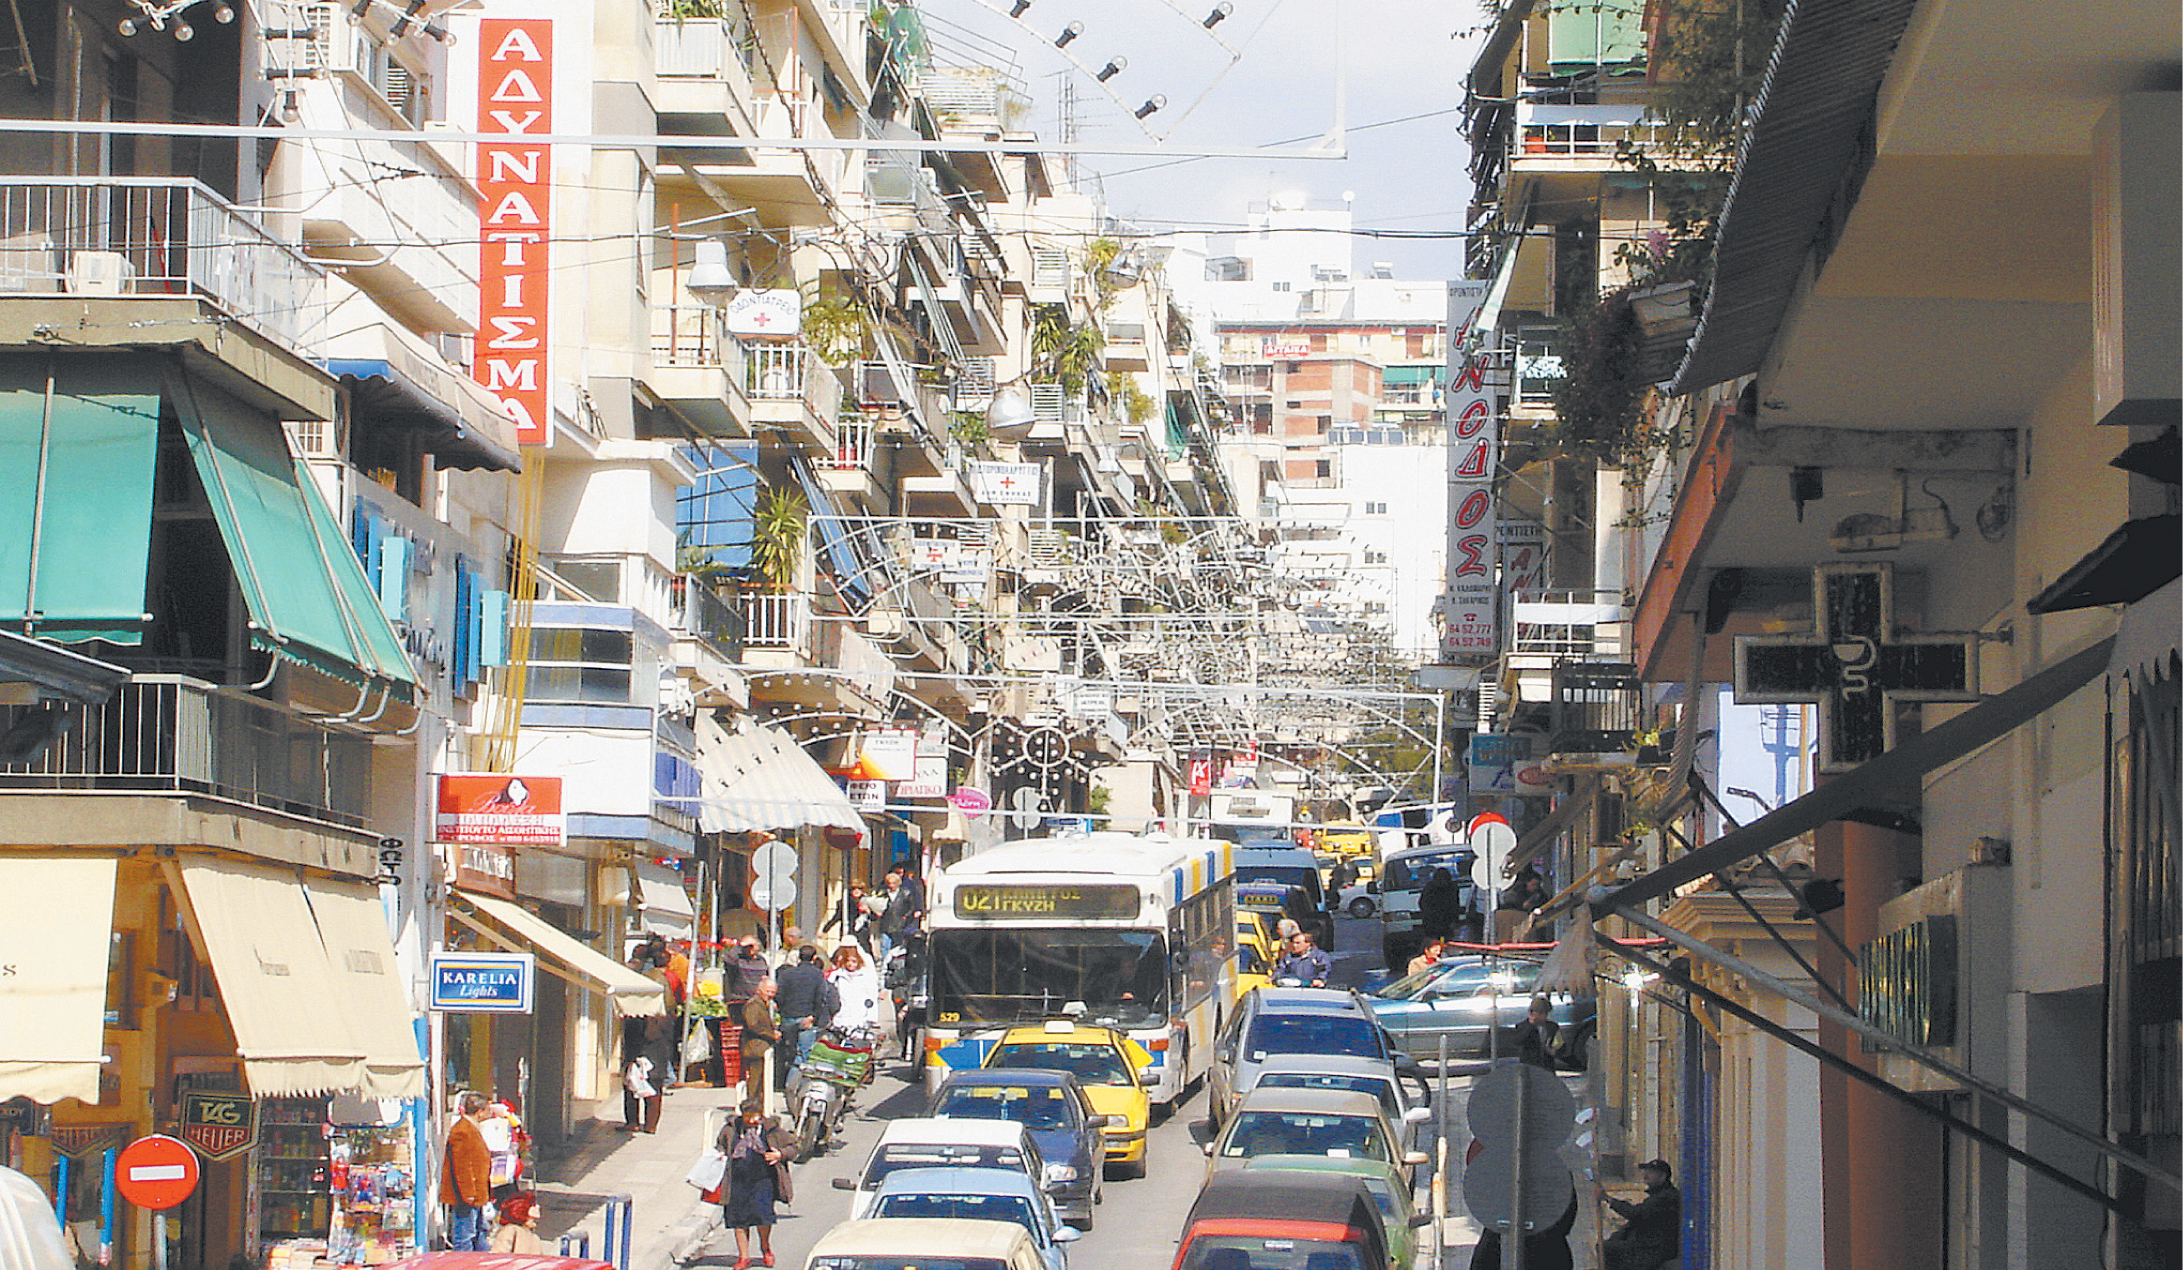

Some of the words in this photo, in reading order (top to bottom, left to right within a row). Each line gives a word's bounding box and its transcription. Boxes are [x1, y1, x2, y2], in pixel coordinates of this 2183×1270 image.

[486, 27, 543, 431] ΑΔΥΝΑΤΙΣΜΑ
[1002, 900, 1055, 912] ΓΚΥΖΗ
[443, 972, 517, 985] KARELIA
[460, 984, 498, 999] Lights
[939, 1011, 960, 1022] 529
[199, 1101, 242, 1124] TAG
[190, 1126, 246, 1150] HEUER
